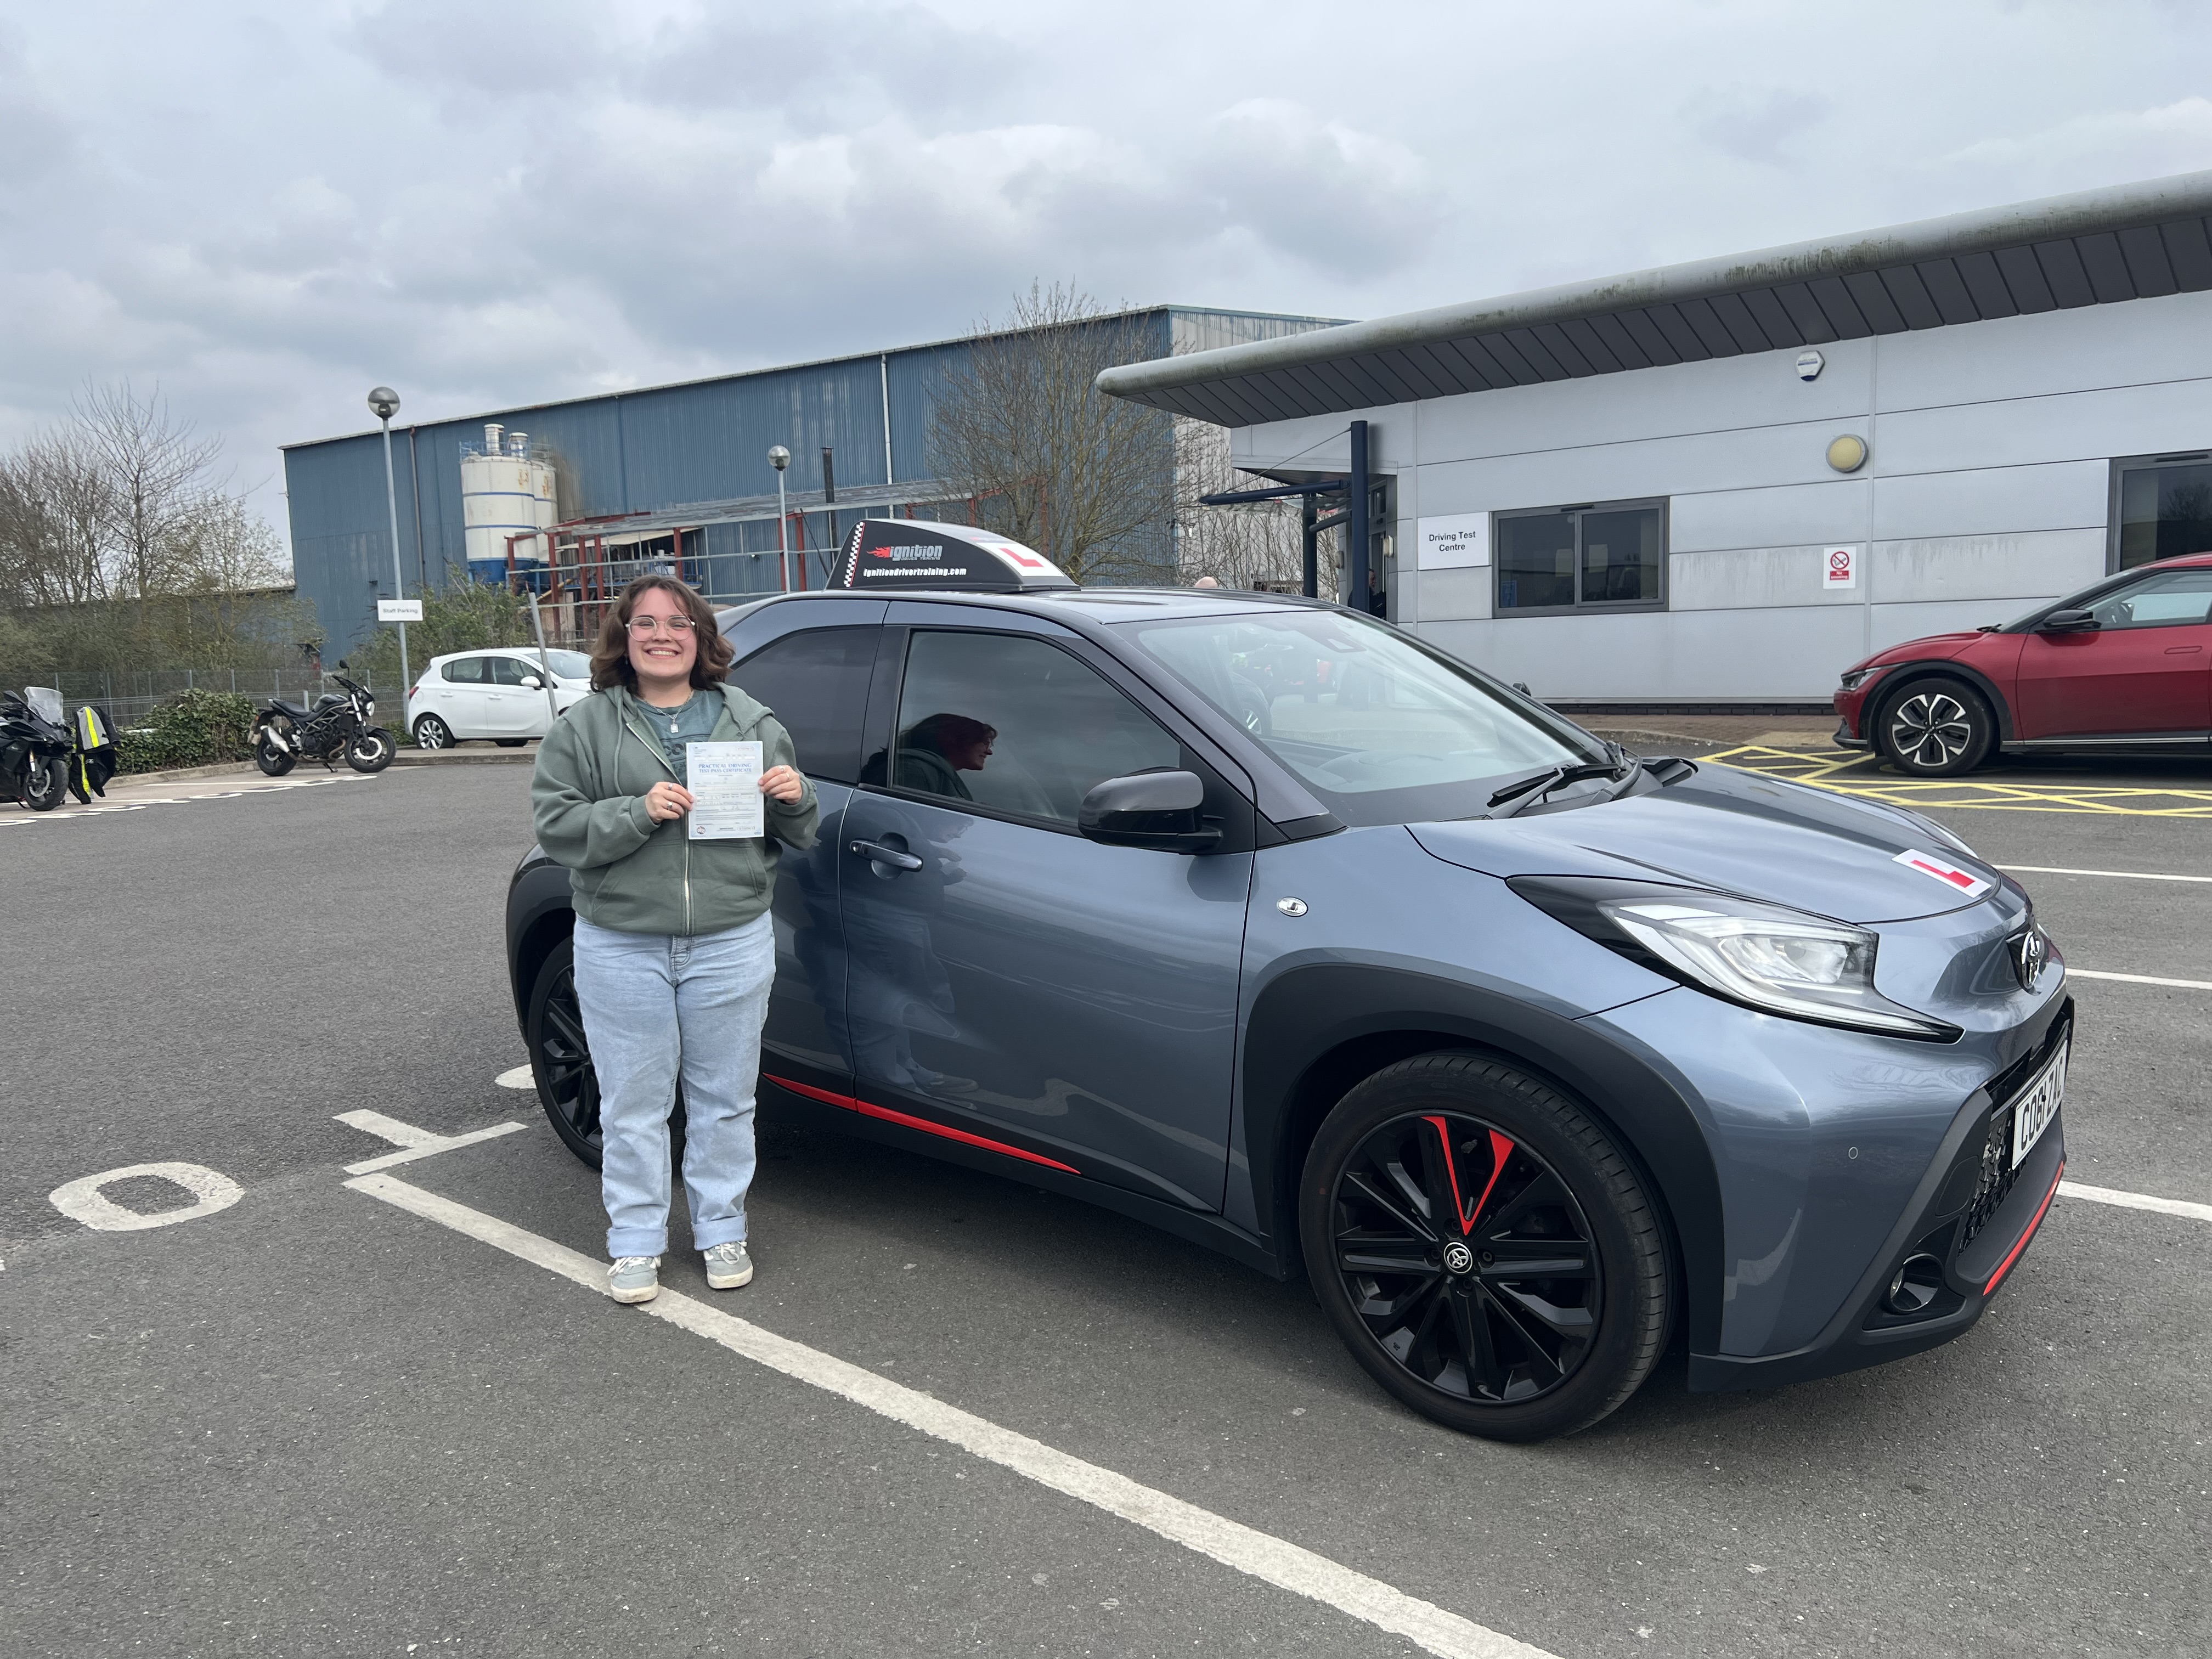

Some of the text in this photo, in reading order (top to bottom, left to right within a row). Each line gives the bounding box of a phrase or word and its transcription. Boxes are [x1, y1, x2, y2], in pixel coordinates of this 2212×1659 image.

[1429, 533, 1456, 541] Driving
[889, 544, 943, 561] ignition
[998, 548, 1045, 567] L
[863, 567, 967, 577] ignitiondrivertraining.com
[1910, 860, 1976, 888] L
